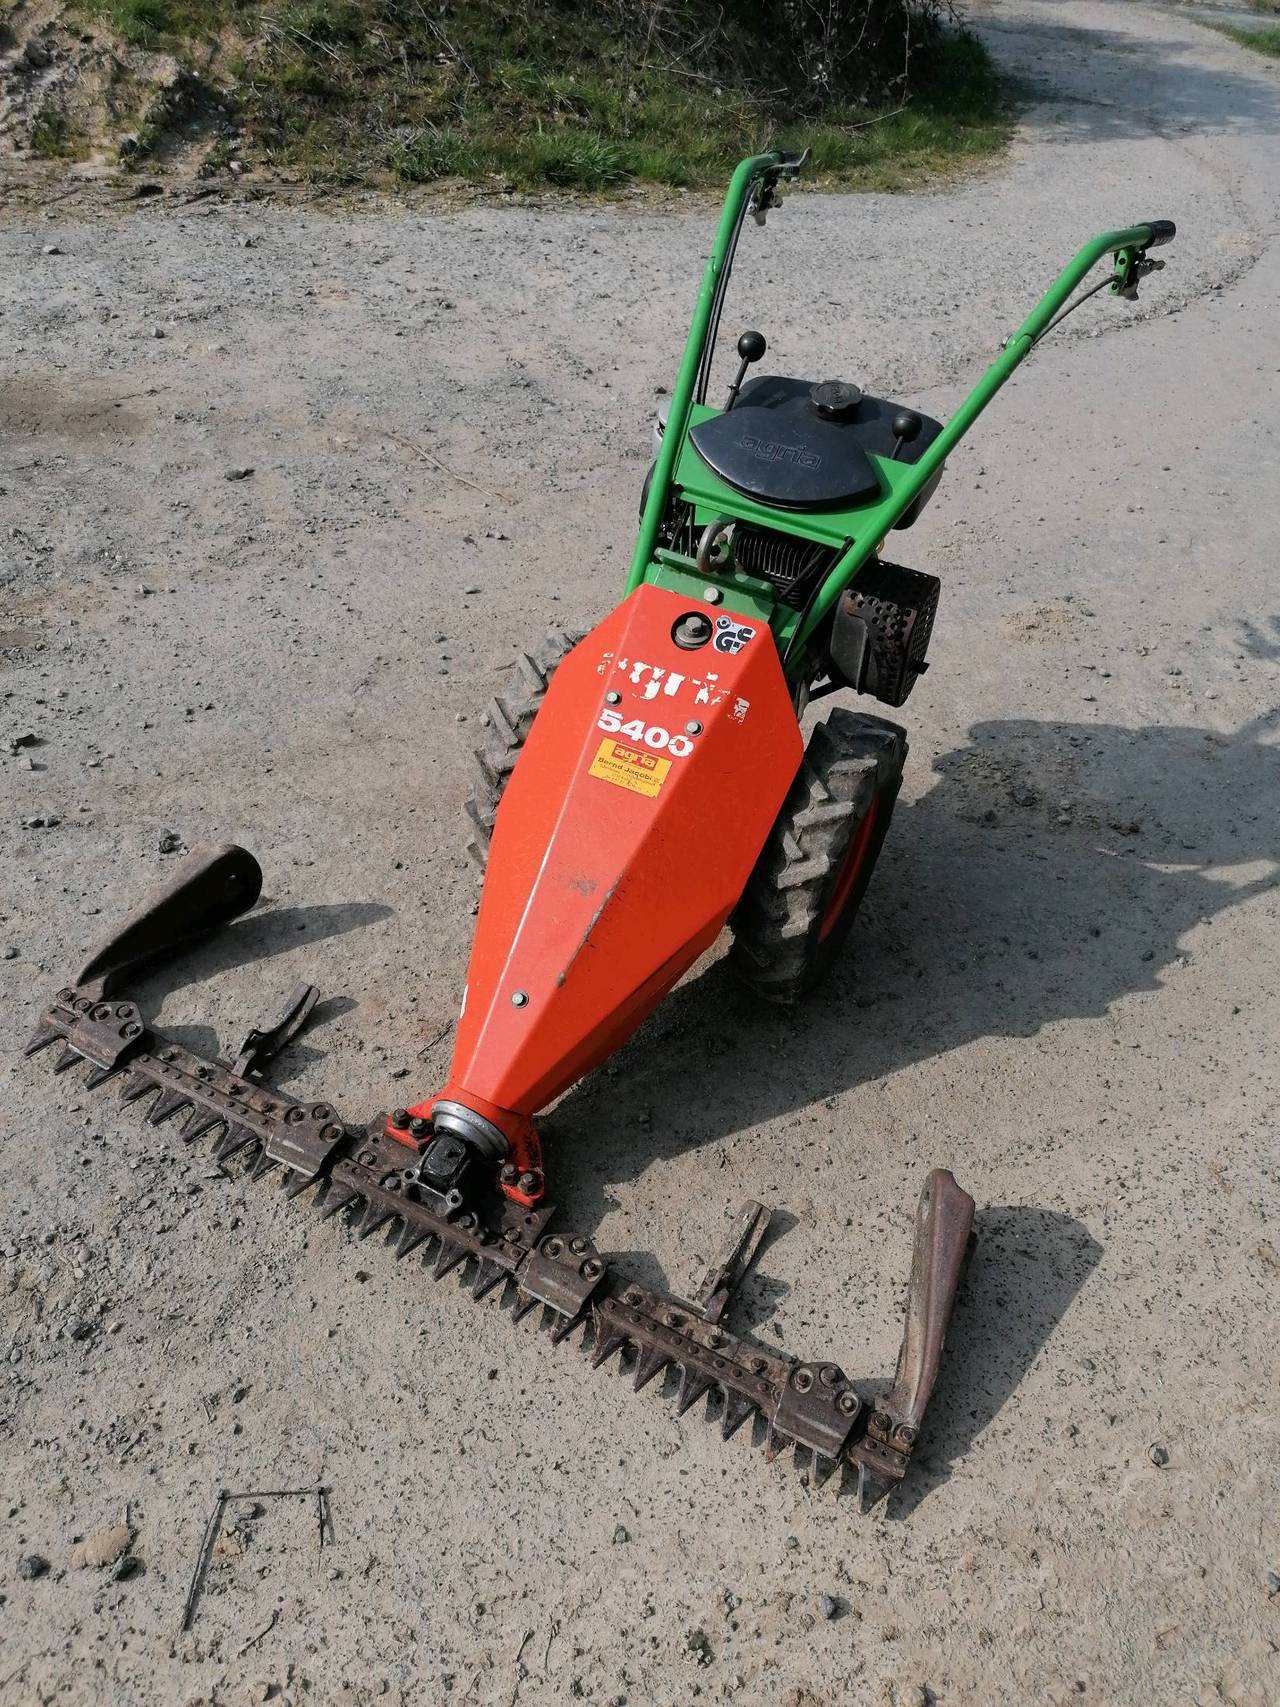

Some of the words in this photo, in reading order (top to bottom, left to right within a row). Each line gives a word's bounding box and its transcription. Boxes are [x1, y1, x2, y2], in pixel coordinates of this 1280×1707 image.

[740, 436, 822, 469] agria
[597, 708, 694, 757] 5400
[597, 756, 624, 771] Bernd
[614, 747, 656, 768] agria
